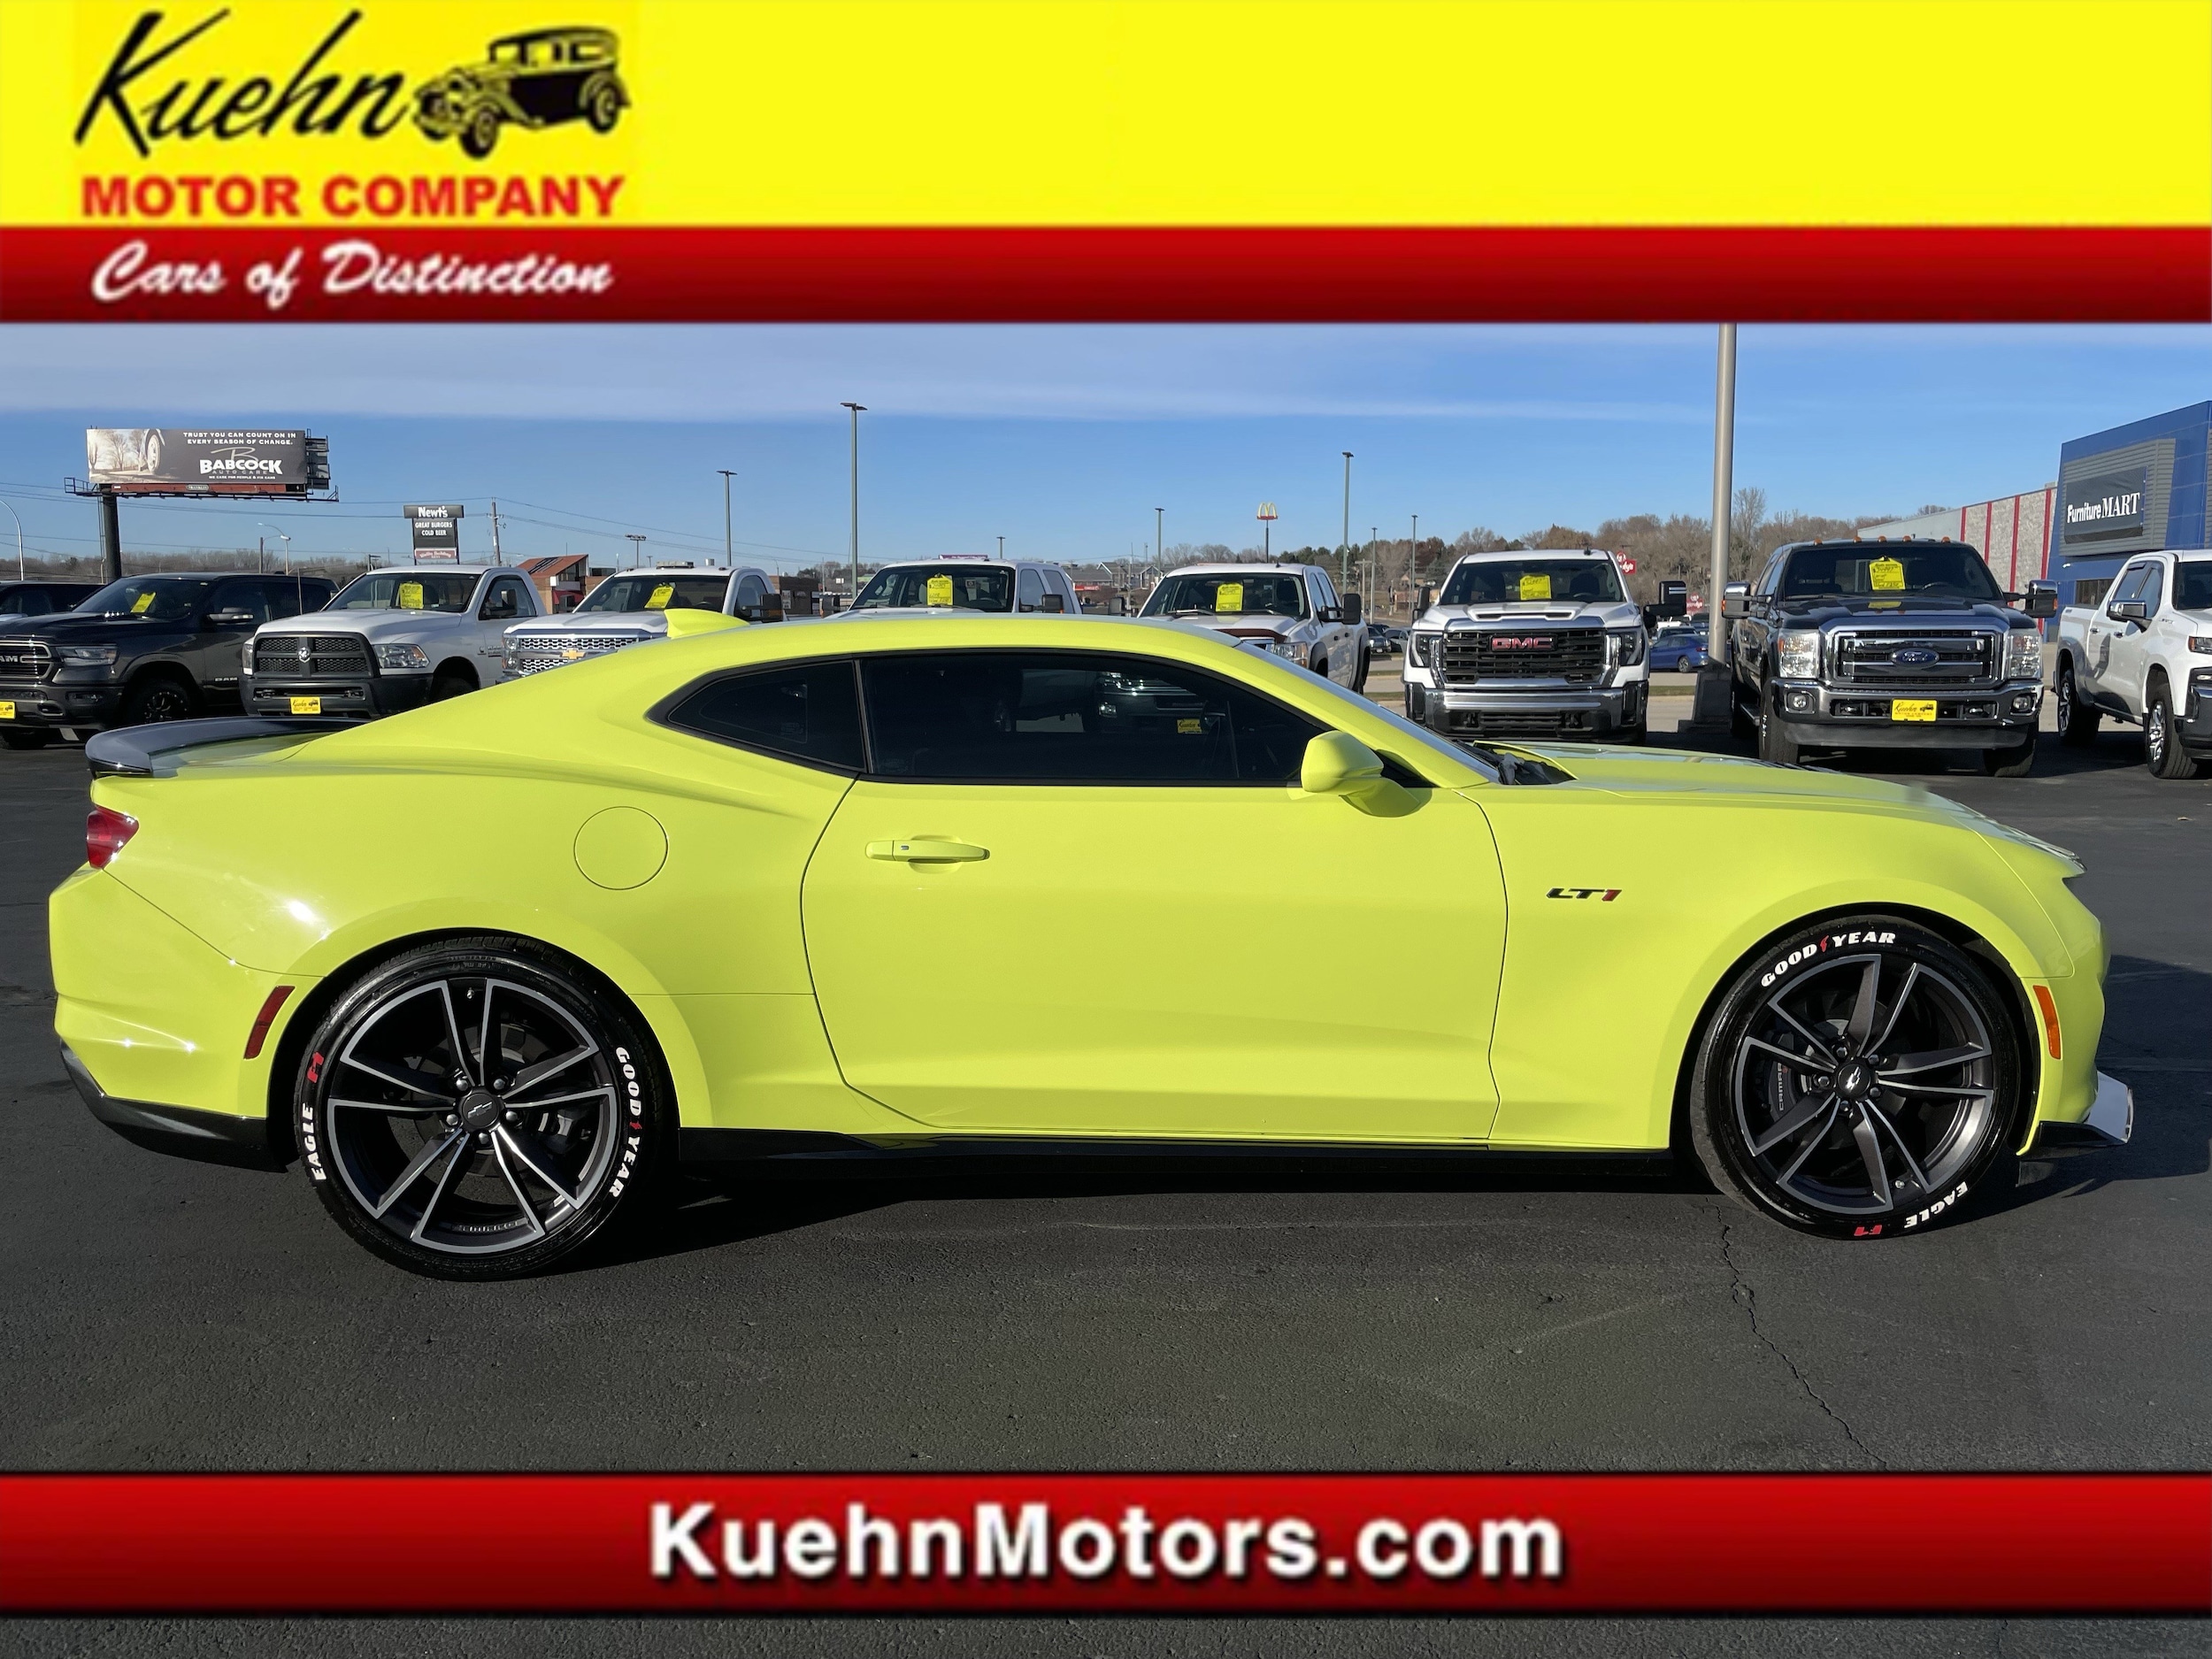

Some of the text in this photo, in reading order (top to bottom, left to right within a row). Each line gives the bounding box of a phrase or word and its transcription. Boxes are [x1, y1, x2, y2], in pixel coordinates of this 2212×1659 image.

[199, 459, 283, 475] BABCOCK
[418, 505, 449, 518] Newt's
[1492, 637, 1553, 649] GMC
[1546, 887, 1622, 902] LT1
[302, 1102, 326, 1180] EAGLE
[1904, 1181, 1969, 1229] EAGLE
[1854, 1225, 1883, 1236] F1
